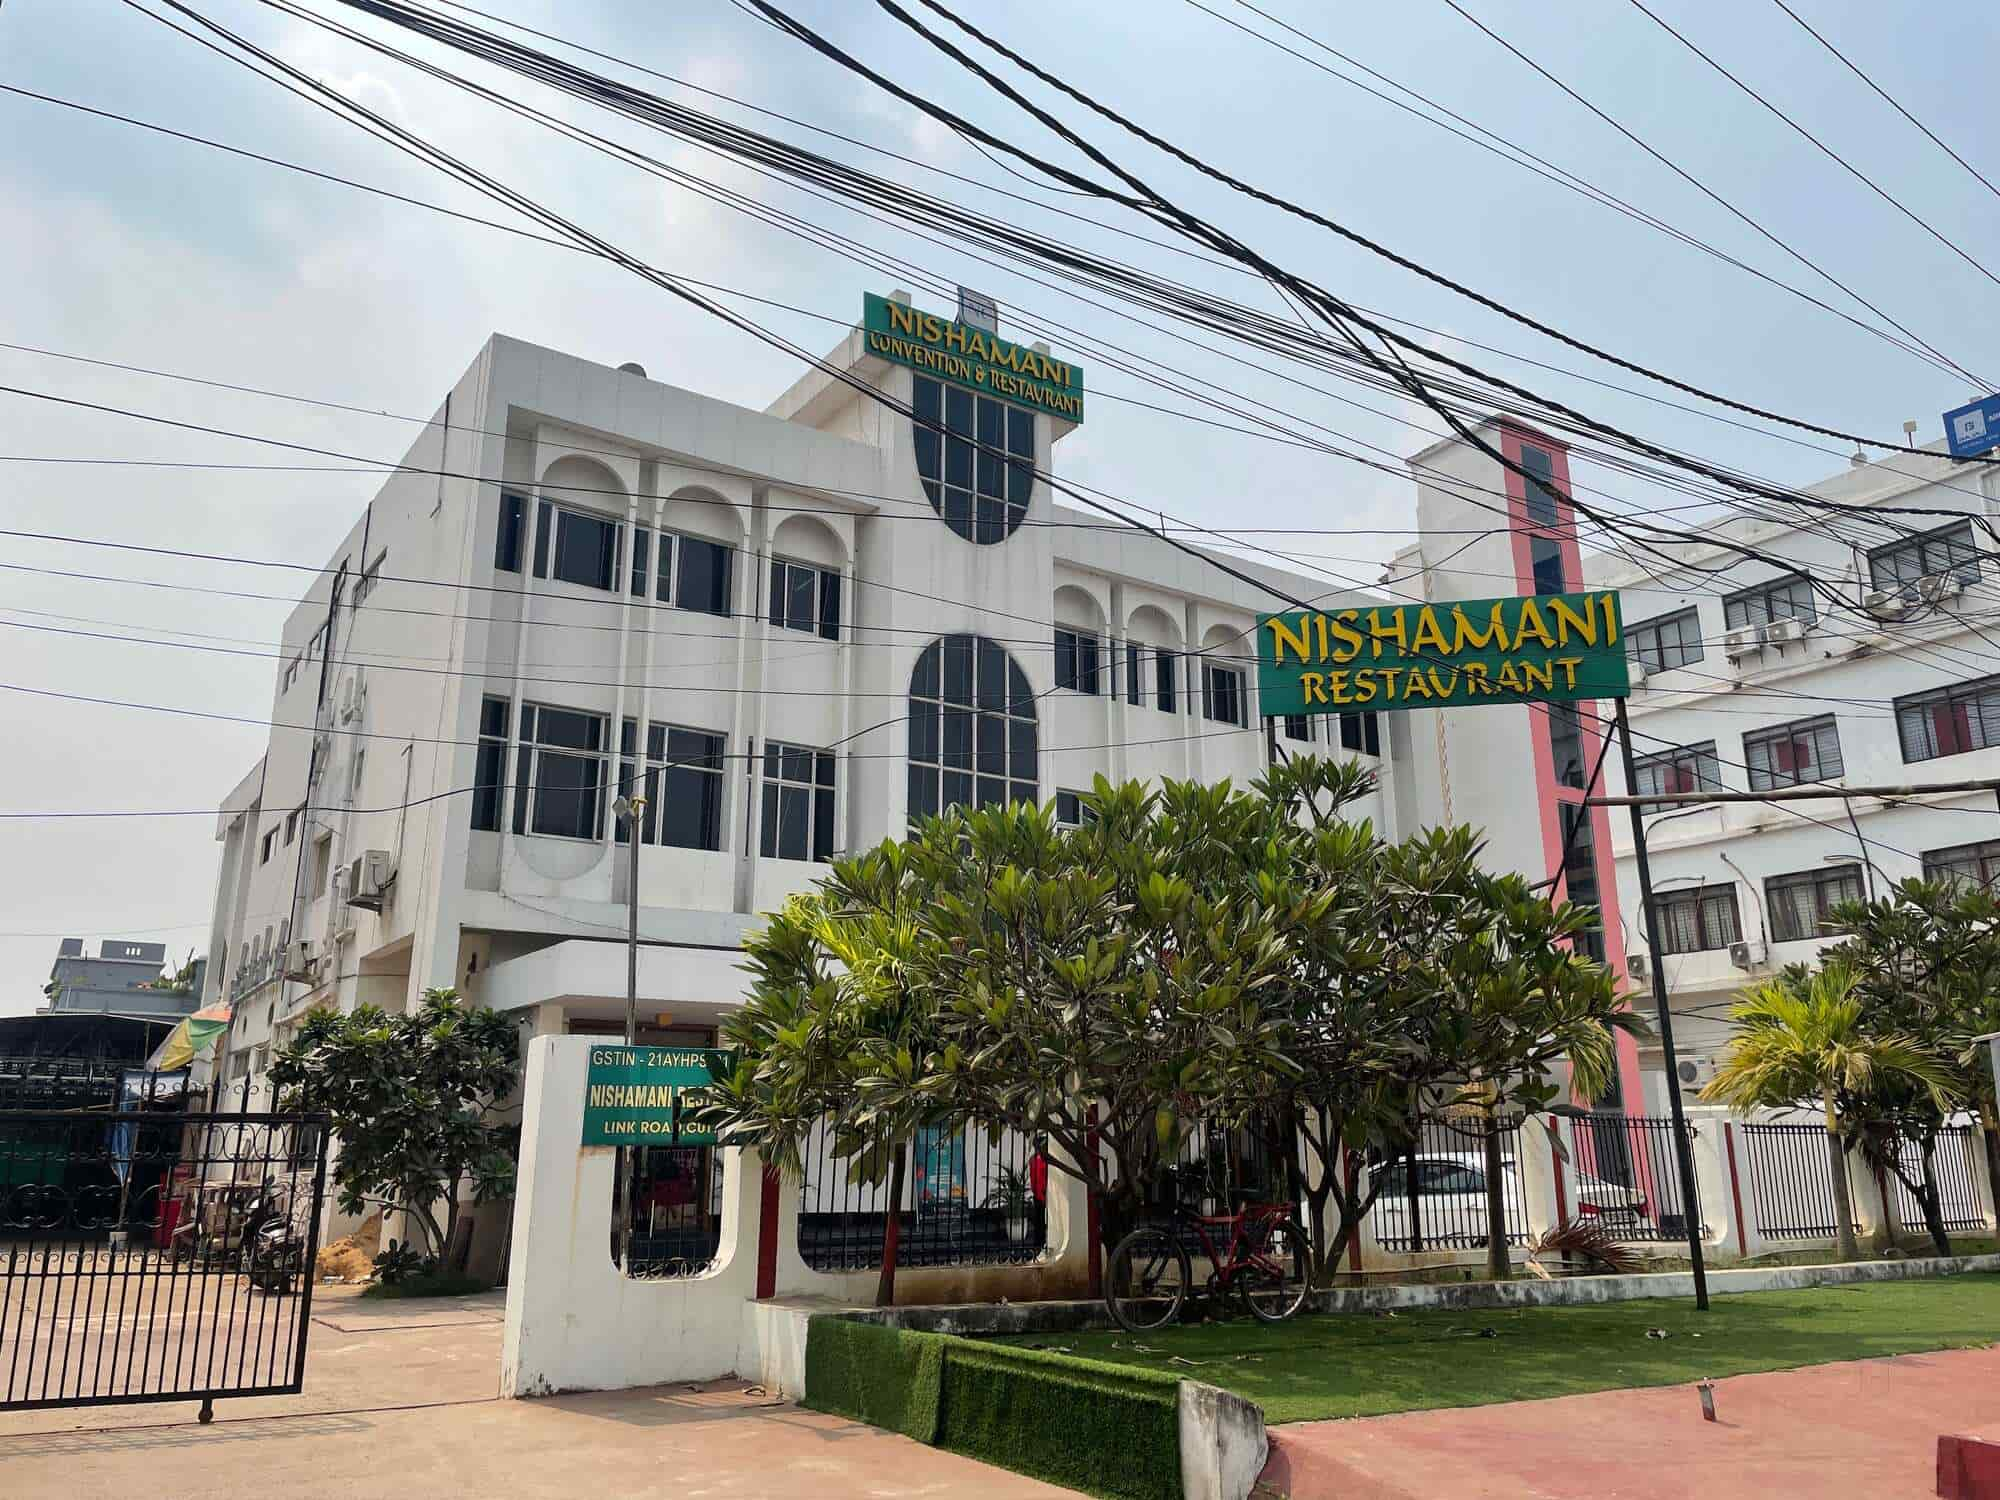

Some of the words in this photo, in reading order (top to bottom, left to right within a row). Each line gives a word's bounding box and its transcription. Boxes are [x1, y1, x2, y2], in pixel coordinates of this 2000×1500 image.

[888, 303, 1073, 387] NISHAMANI
[870, 332, 970, 383] CONVENTION
[975, 365, 986, 383] &
[991, 368, 1081, 416] RESTAURANT
[1265, 592, 1618, 668] NISHAMANI
[1300, 656, 1584, 705] RESTAURANT
[592, 1050, 635, 1066] GSTIN
[590, 1085, 673, 1108] NISHAMANI
[604, 1121, 635, 1134] LINK
